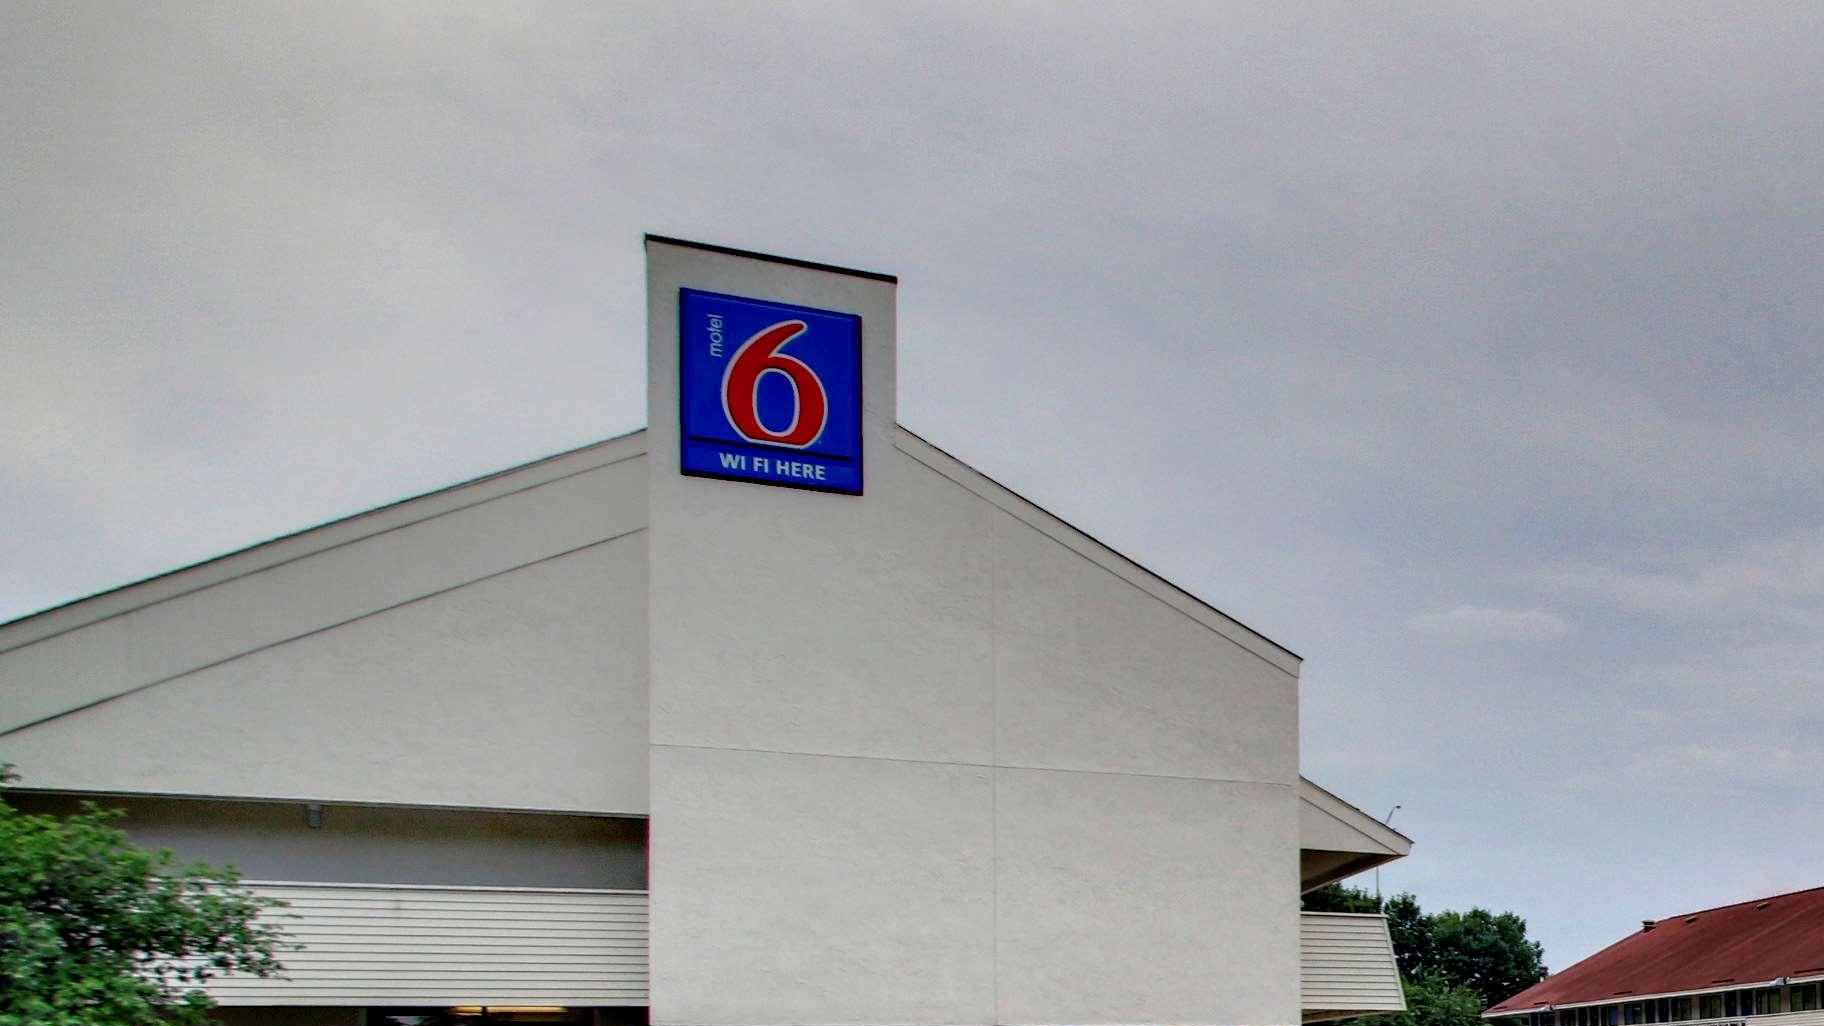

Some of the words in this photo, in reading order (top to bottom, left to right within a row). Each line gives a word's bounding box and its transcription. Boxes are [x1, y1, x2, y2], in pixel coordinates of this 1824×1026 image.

[706, 313, 724, 358] motel
[721, 319, 828, 449] 6
[718, 452, 746, 471] WI
[752, 457, 769, 474] FI
[775, 460, 827, 481] HERE
